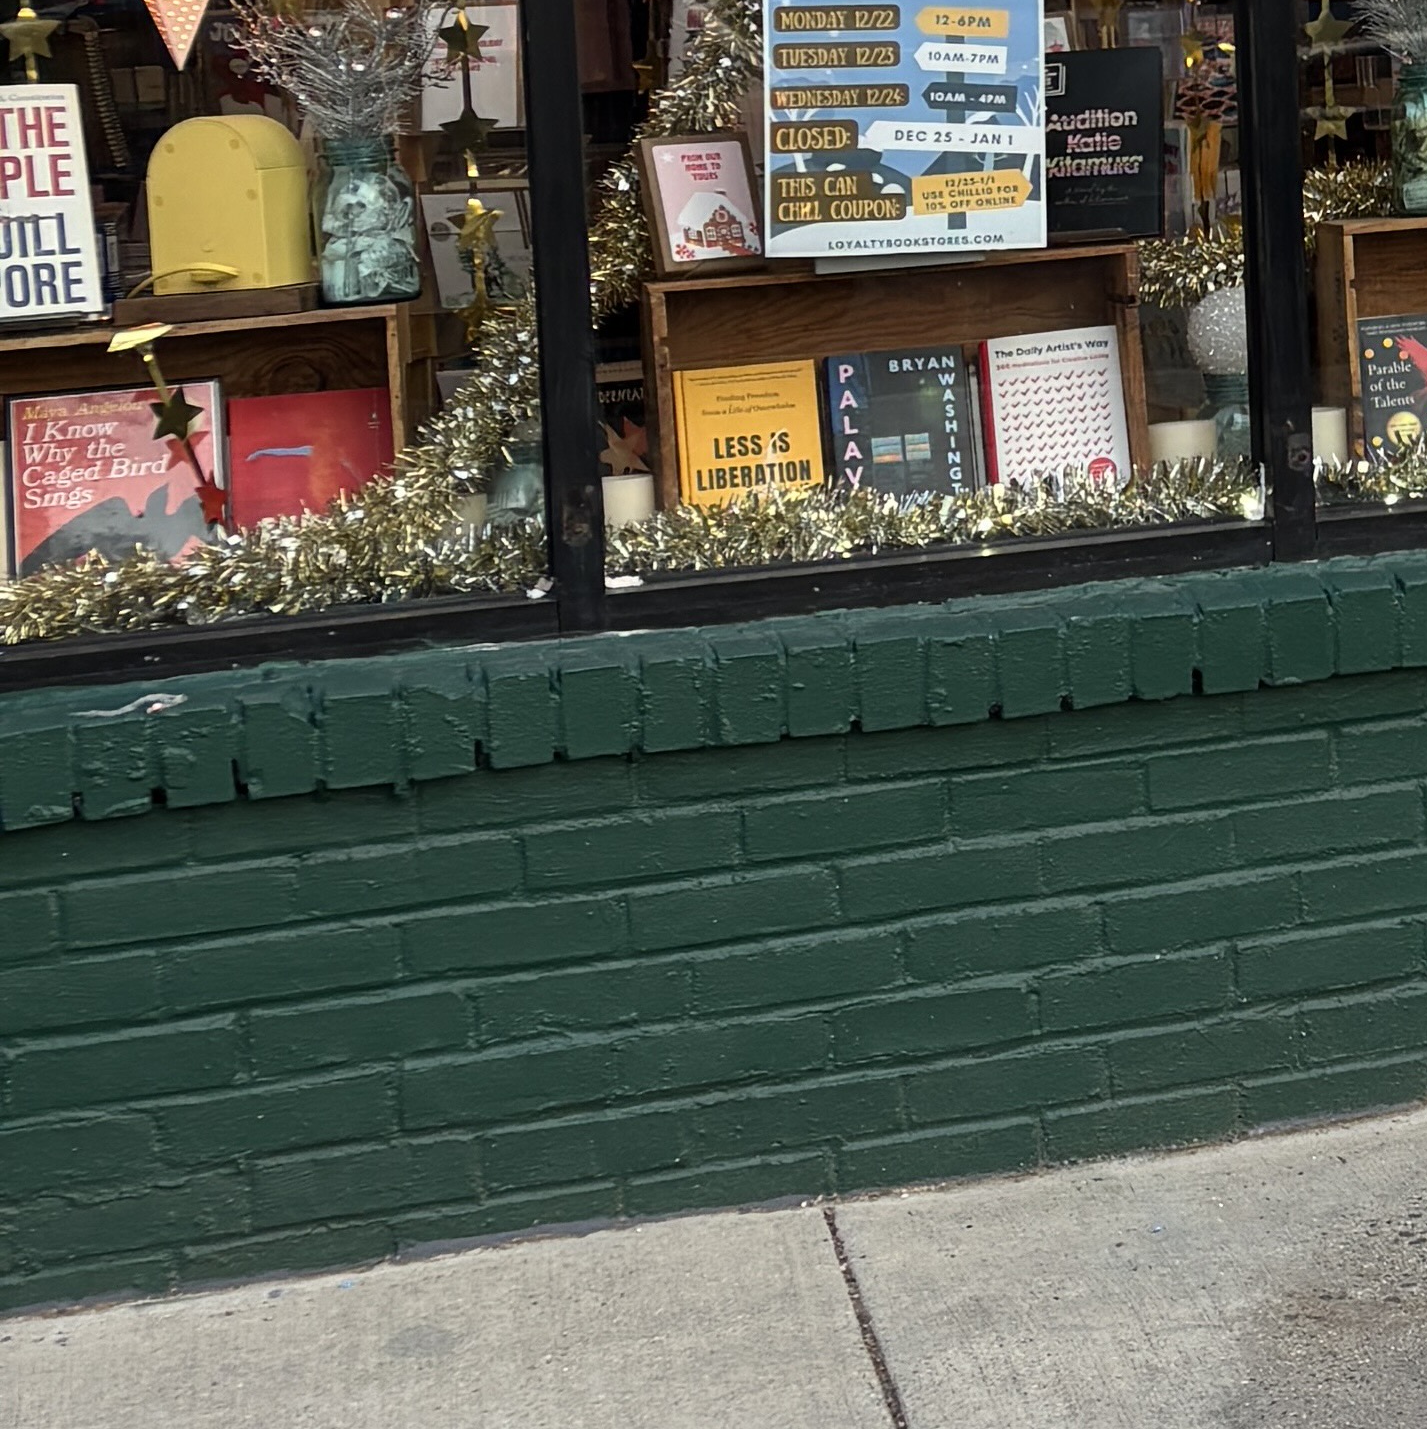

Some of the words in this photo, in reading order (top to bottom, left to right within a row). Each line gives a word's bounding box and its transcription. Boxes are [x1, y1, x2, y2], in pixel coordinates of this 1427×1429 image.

[780, 10, 848, 30] MONDAY
[854, 9, 895, 29] 12/22
[934, 14, 992, 28] 12-6PM
[779, 47, 850, 68] TUESDAY
[855, 46, 896, 66] 12/23
[927, 51, 1000, 64] 10AM-7PM
[774, 89, 861, 108] WEDNESDAY
[929, 91, 966, 103] 10AM
[0, 106, 71, 150] THE
[1046, 108, 1139, 132] Audition
[775, 126, 851, 151] CLOSED:
[894, 129, 928, 143] DEC
[933, 131, 953, 143] 25
[970, 132, 1002, 146] JAN
[1008, 134, 1014, 146] 1
[1066, 131, 1122, 154] Katie
[1046, 153, 1144, 179] Kitamura
[777, 177, 816, 198] THIS
[823, 175, 857, 196] CAN
[921, 189, 944, 201] USE
[777, 201, 822, 222] CHILL
[830, 198, 900, 221] COUPON:
[951, 198, 972, 210] OFF
[828, 234, 1004, 250] LOYALTYBOOKSTORES.COM
[994, 349, 1014, 359] The
[1016, 346, 1043, 358] Daily
[1045, 342, 1083, 354] Artist's
[1084, 339, 1110, 350] Way
[888, 355, 955, 374] BRYAN
[1367, 360, 1412, 377] Parable
[1369, 377, 1383, 393] of
[1386, 377, 1406, 391] the
[22, 404, 68, 421] Maya
[74, 400, 145, 418] Angelou
[1370, 394, 1416, 409] Talents
[22, 422, 37, 445] I
[42, 419, 119, 443] Know
[22, 443, 78, 467] Why
[86, 441, 126, 460] the
[713, 434, 763, 460] LESS
[22, 460, 102, 489] Caged
[107, 452, 171, 480] Bird
[696, 458, 812, 492] LIBERATION
[23, 487, 94, 511] Sings
